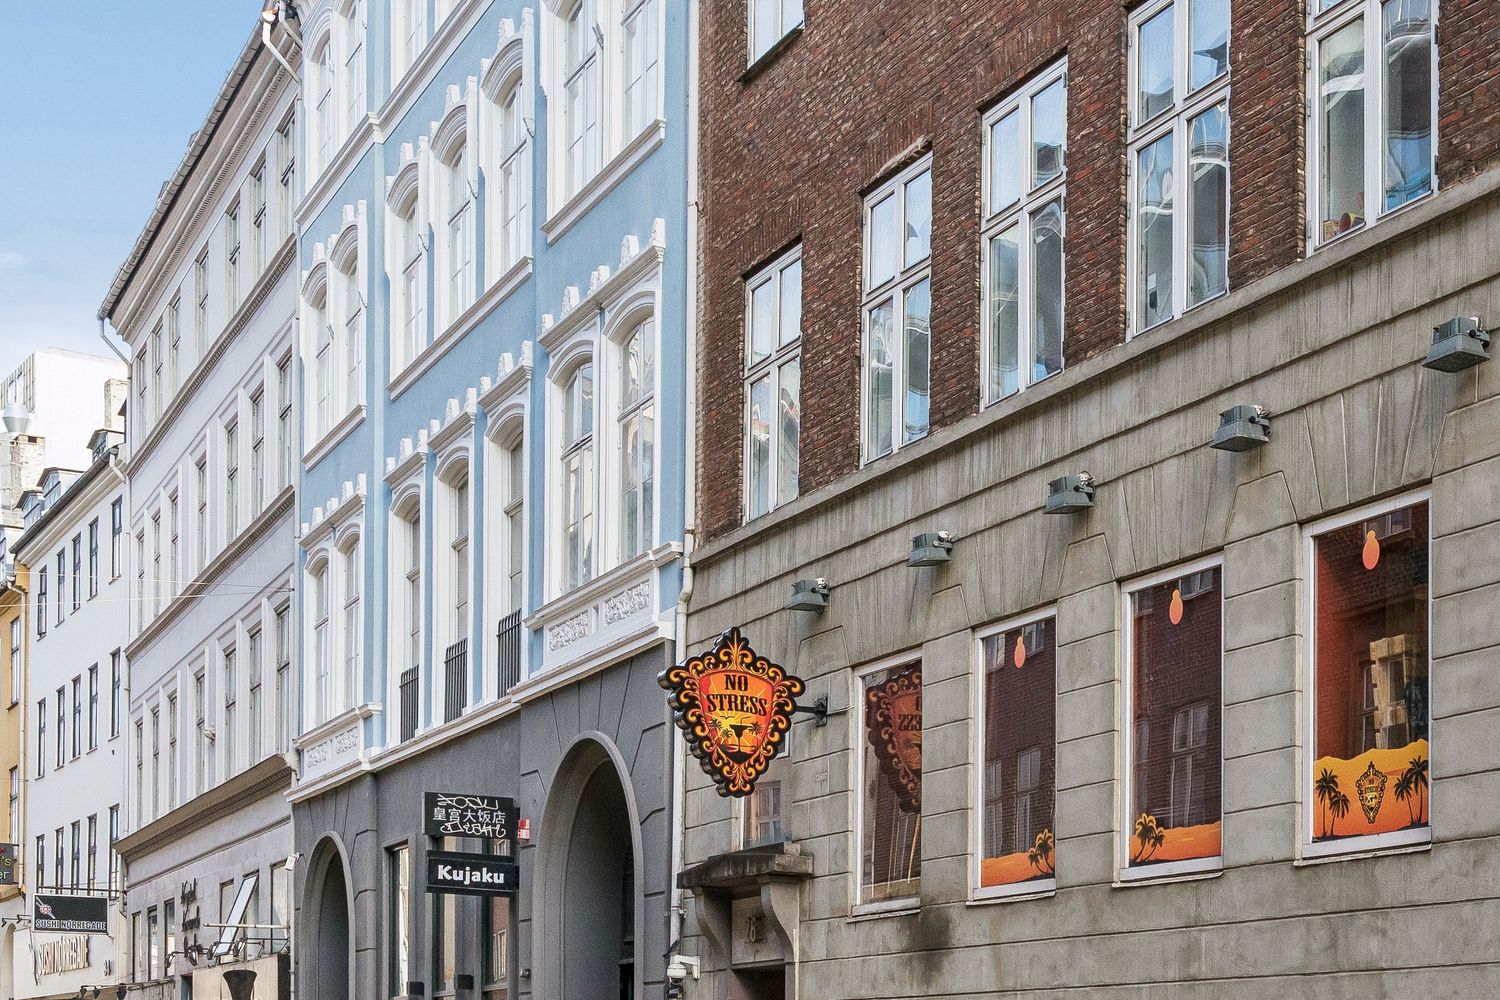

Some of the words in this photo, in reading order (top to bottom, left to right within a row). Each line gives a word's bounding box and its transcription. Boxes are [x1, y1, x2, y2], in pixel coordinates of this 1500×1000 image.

[724, 674, 748, 692] NO
[706, 693, 767, 717] STRESS
[433, 807, 506, 825] 皇宫大饭店
[437, 865, 504, 885] Kujaku
[35, 919, 60, 929] SUSHI
